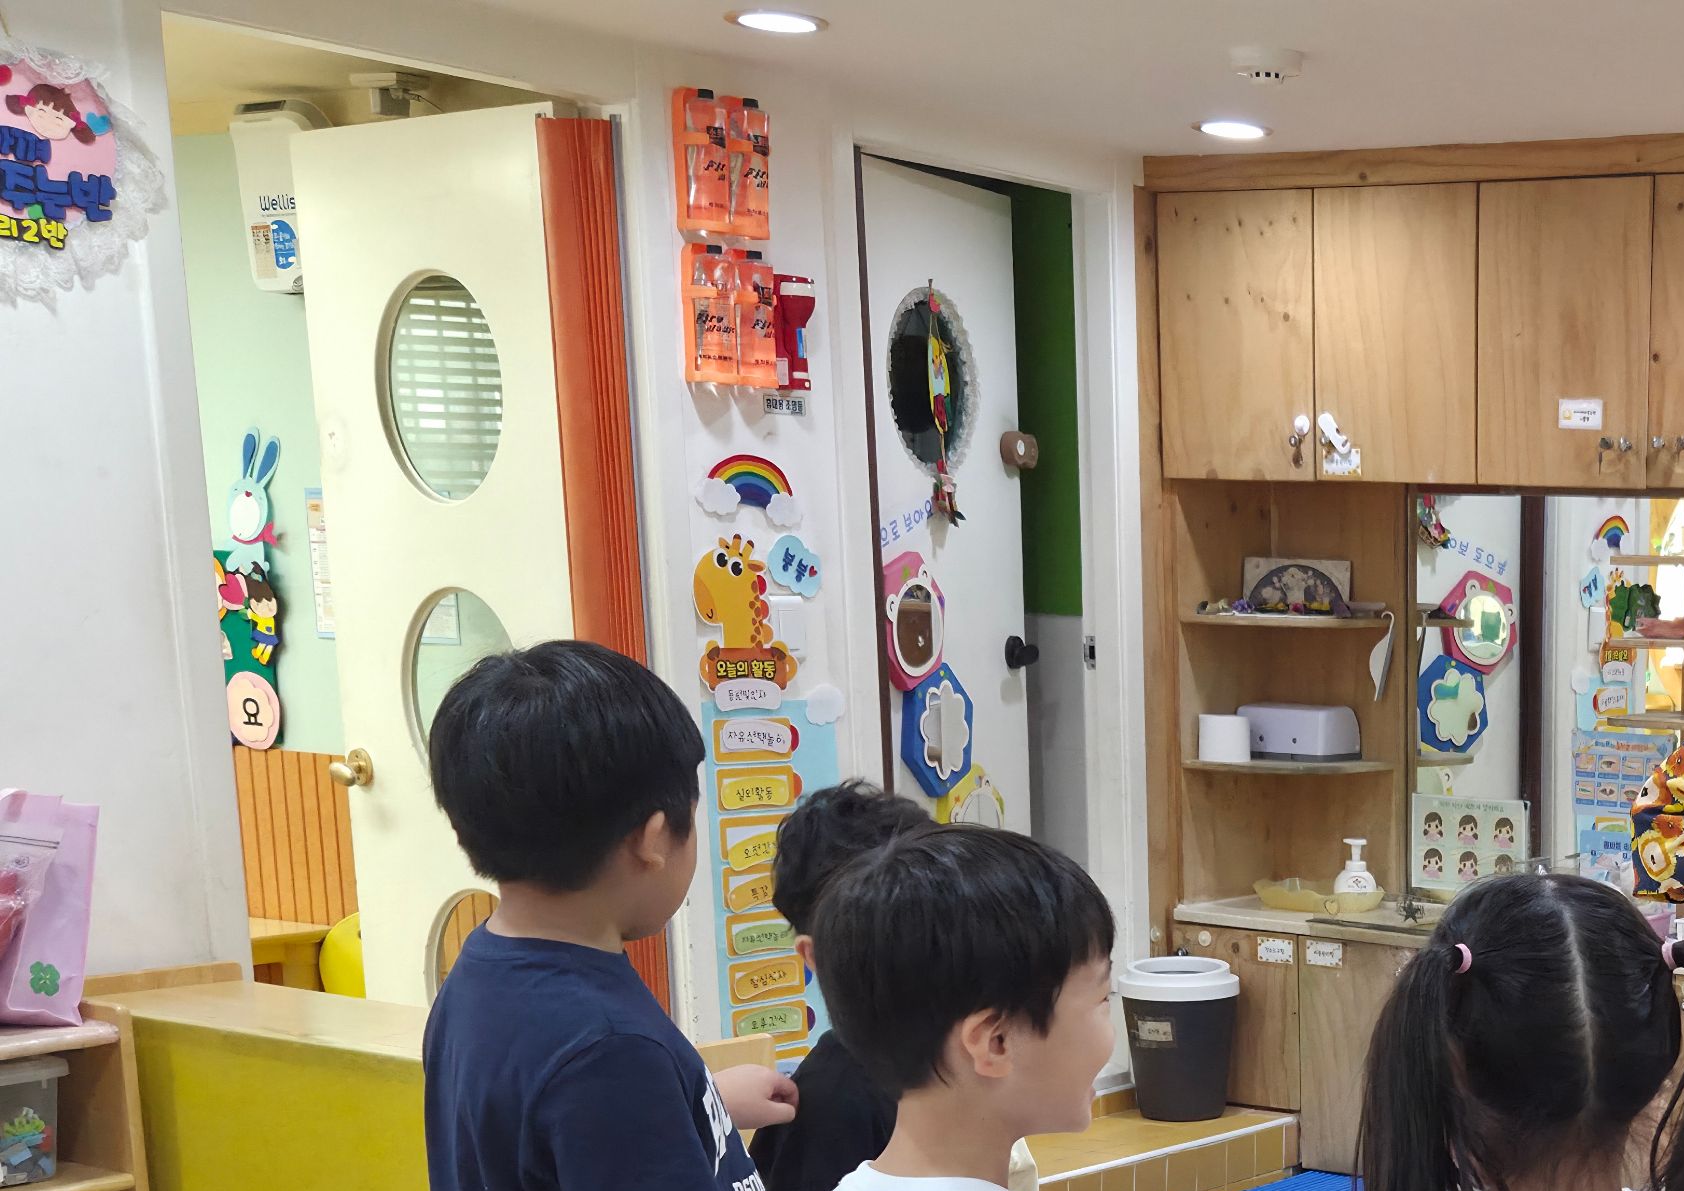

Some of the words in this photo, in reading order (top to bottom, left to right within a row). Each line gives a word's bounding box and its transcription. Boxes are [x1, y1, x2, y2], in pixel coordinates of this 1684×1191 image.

[716, 659, 749, 679] 오늘의
[750, 659, 777, 679] 활동
[735, 786, 773, 802] 실외활동
[751, 1013, 787, 1031] 오후간식
